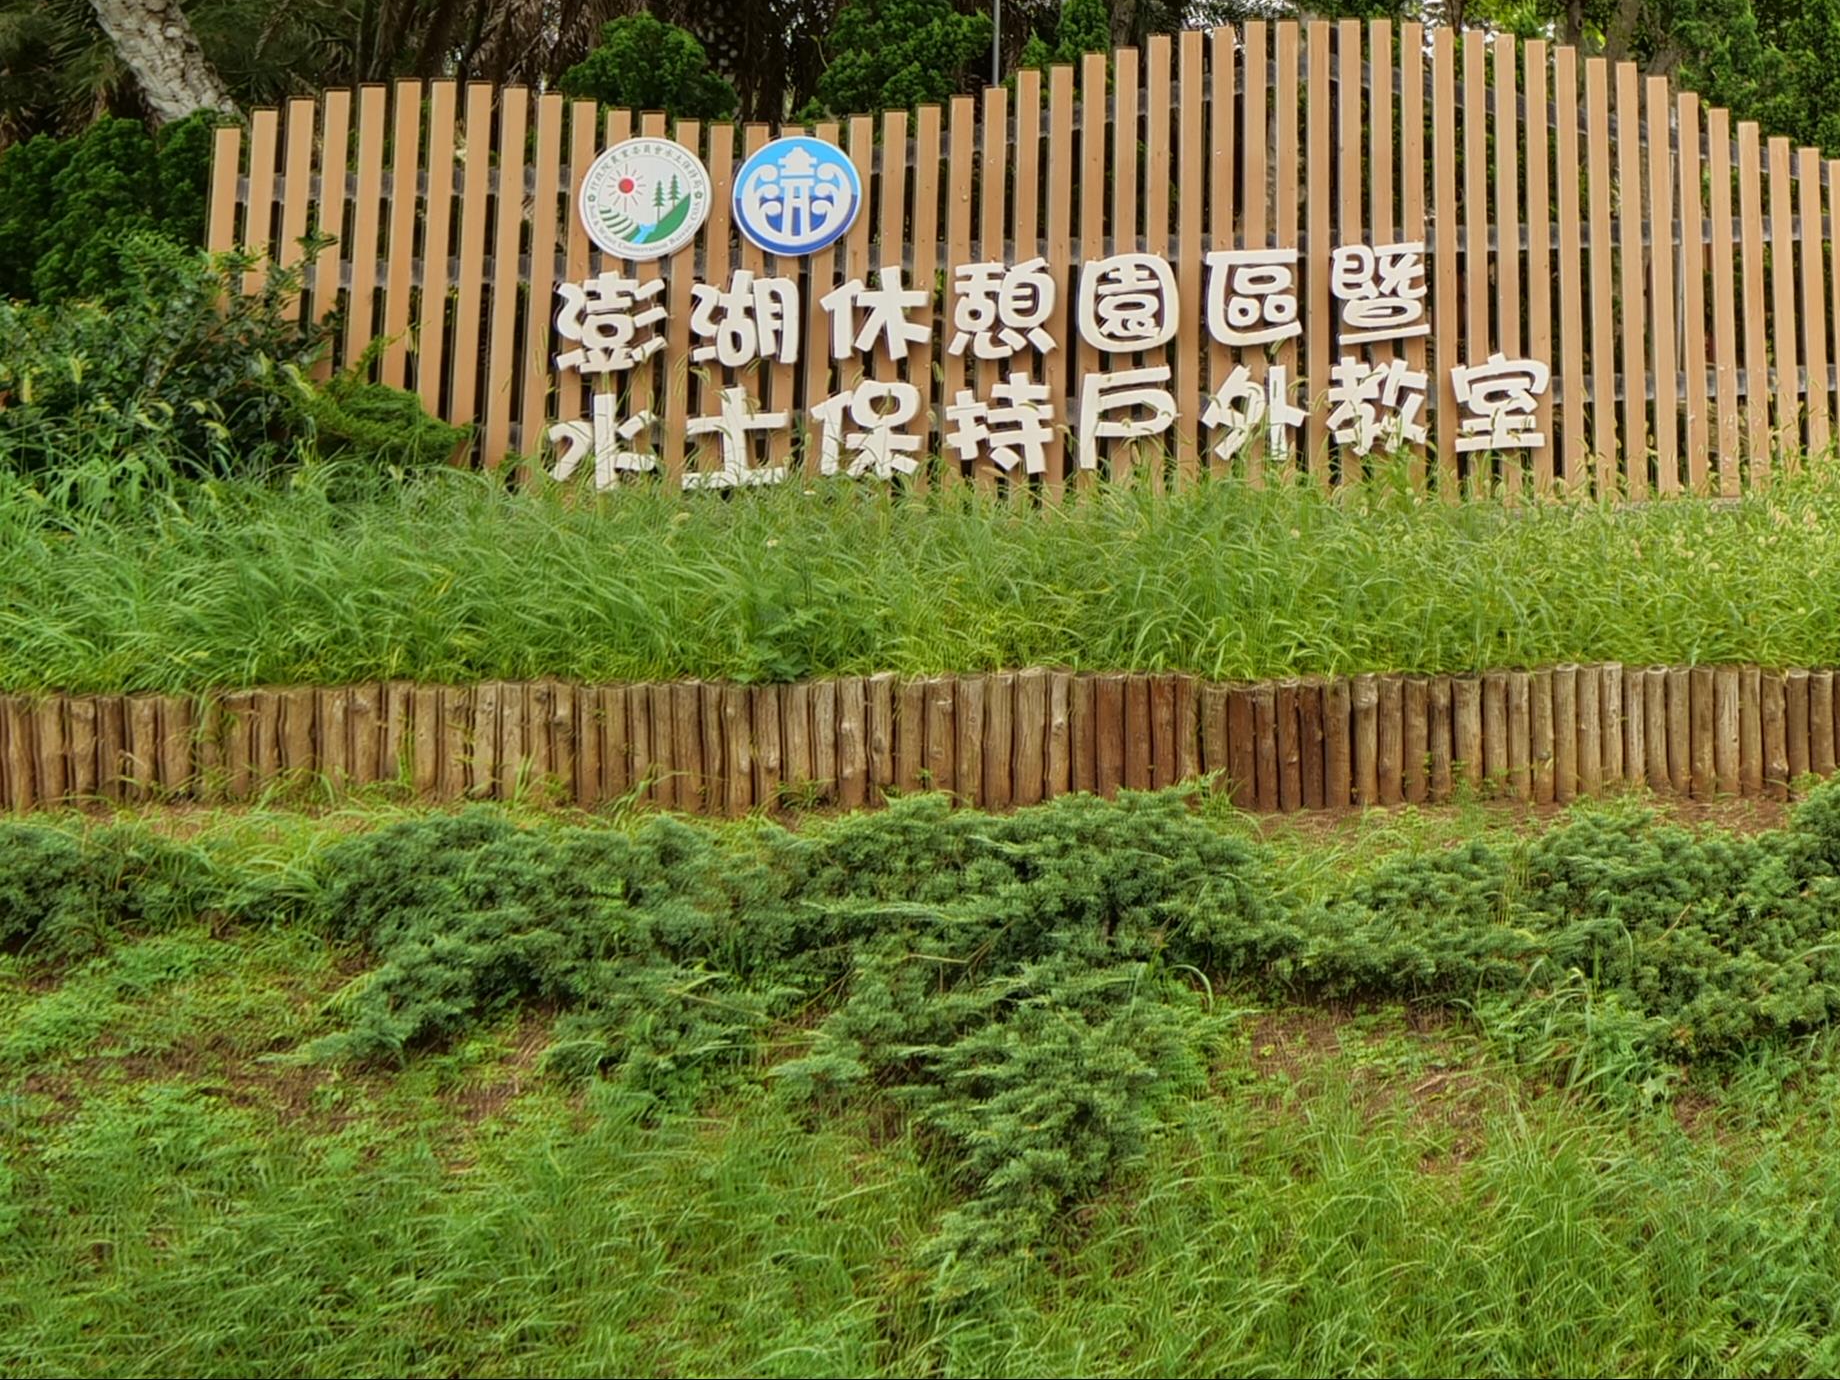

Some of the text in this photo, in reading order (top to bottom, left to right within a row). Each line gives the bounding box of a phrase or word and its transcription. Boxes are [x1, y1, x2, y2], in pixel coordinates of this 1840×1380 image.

[555, 242, 1431, 374] 澎湖休憩園區暨
[549, 352, 1549, 491] 水土保持戶外教室
